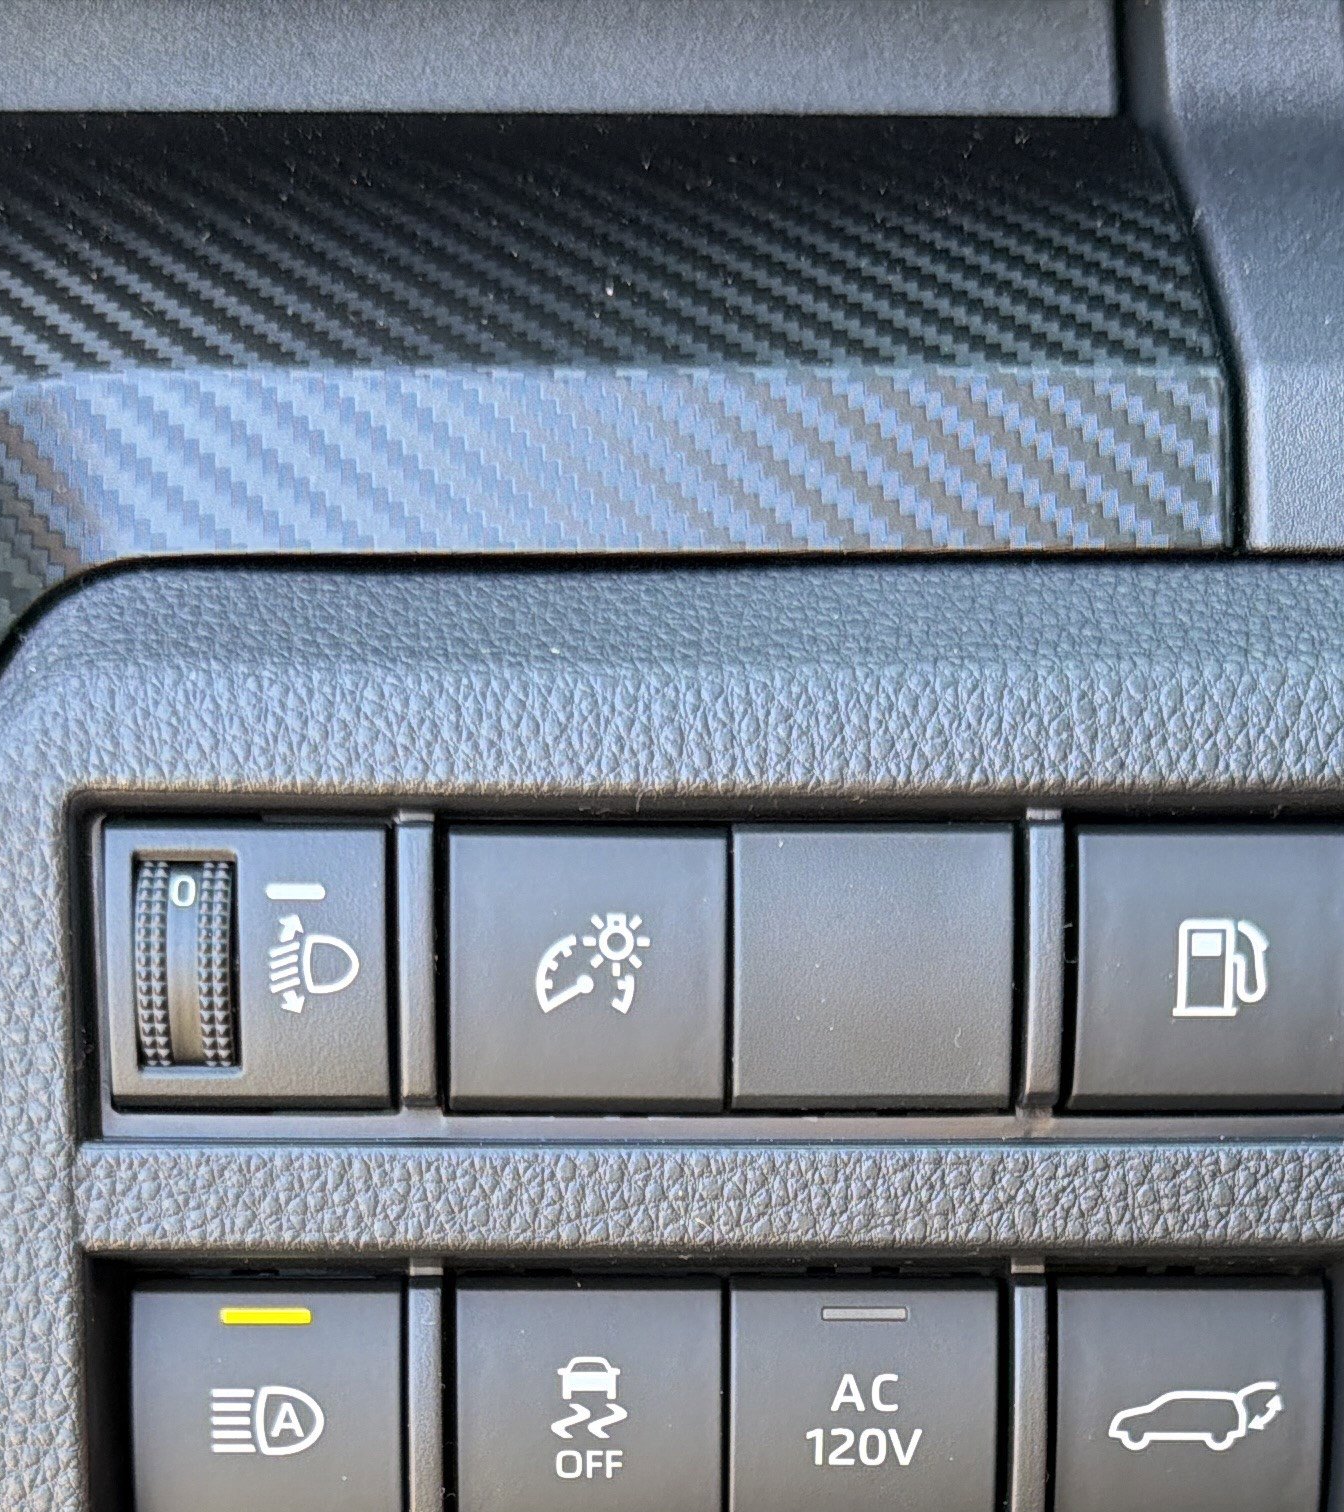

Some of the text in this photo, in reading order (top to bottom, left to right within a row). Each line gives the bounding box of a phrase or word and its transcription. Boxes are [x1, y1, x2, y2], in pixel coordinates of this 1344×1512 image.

[169, 875, 196, 907] 0
[830, 1373, 899, 1412] AC
[270, 1402, 305, 1437] A
[555, 1449, 623, 1479] OFF
[805, 1428, 923, 1466] 120V
